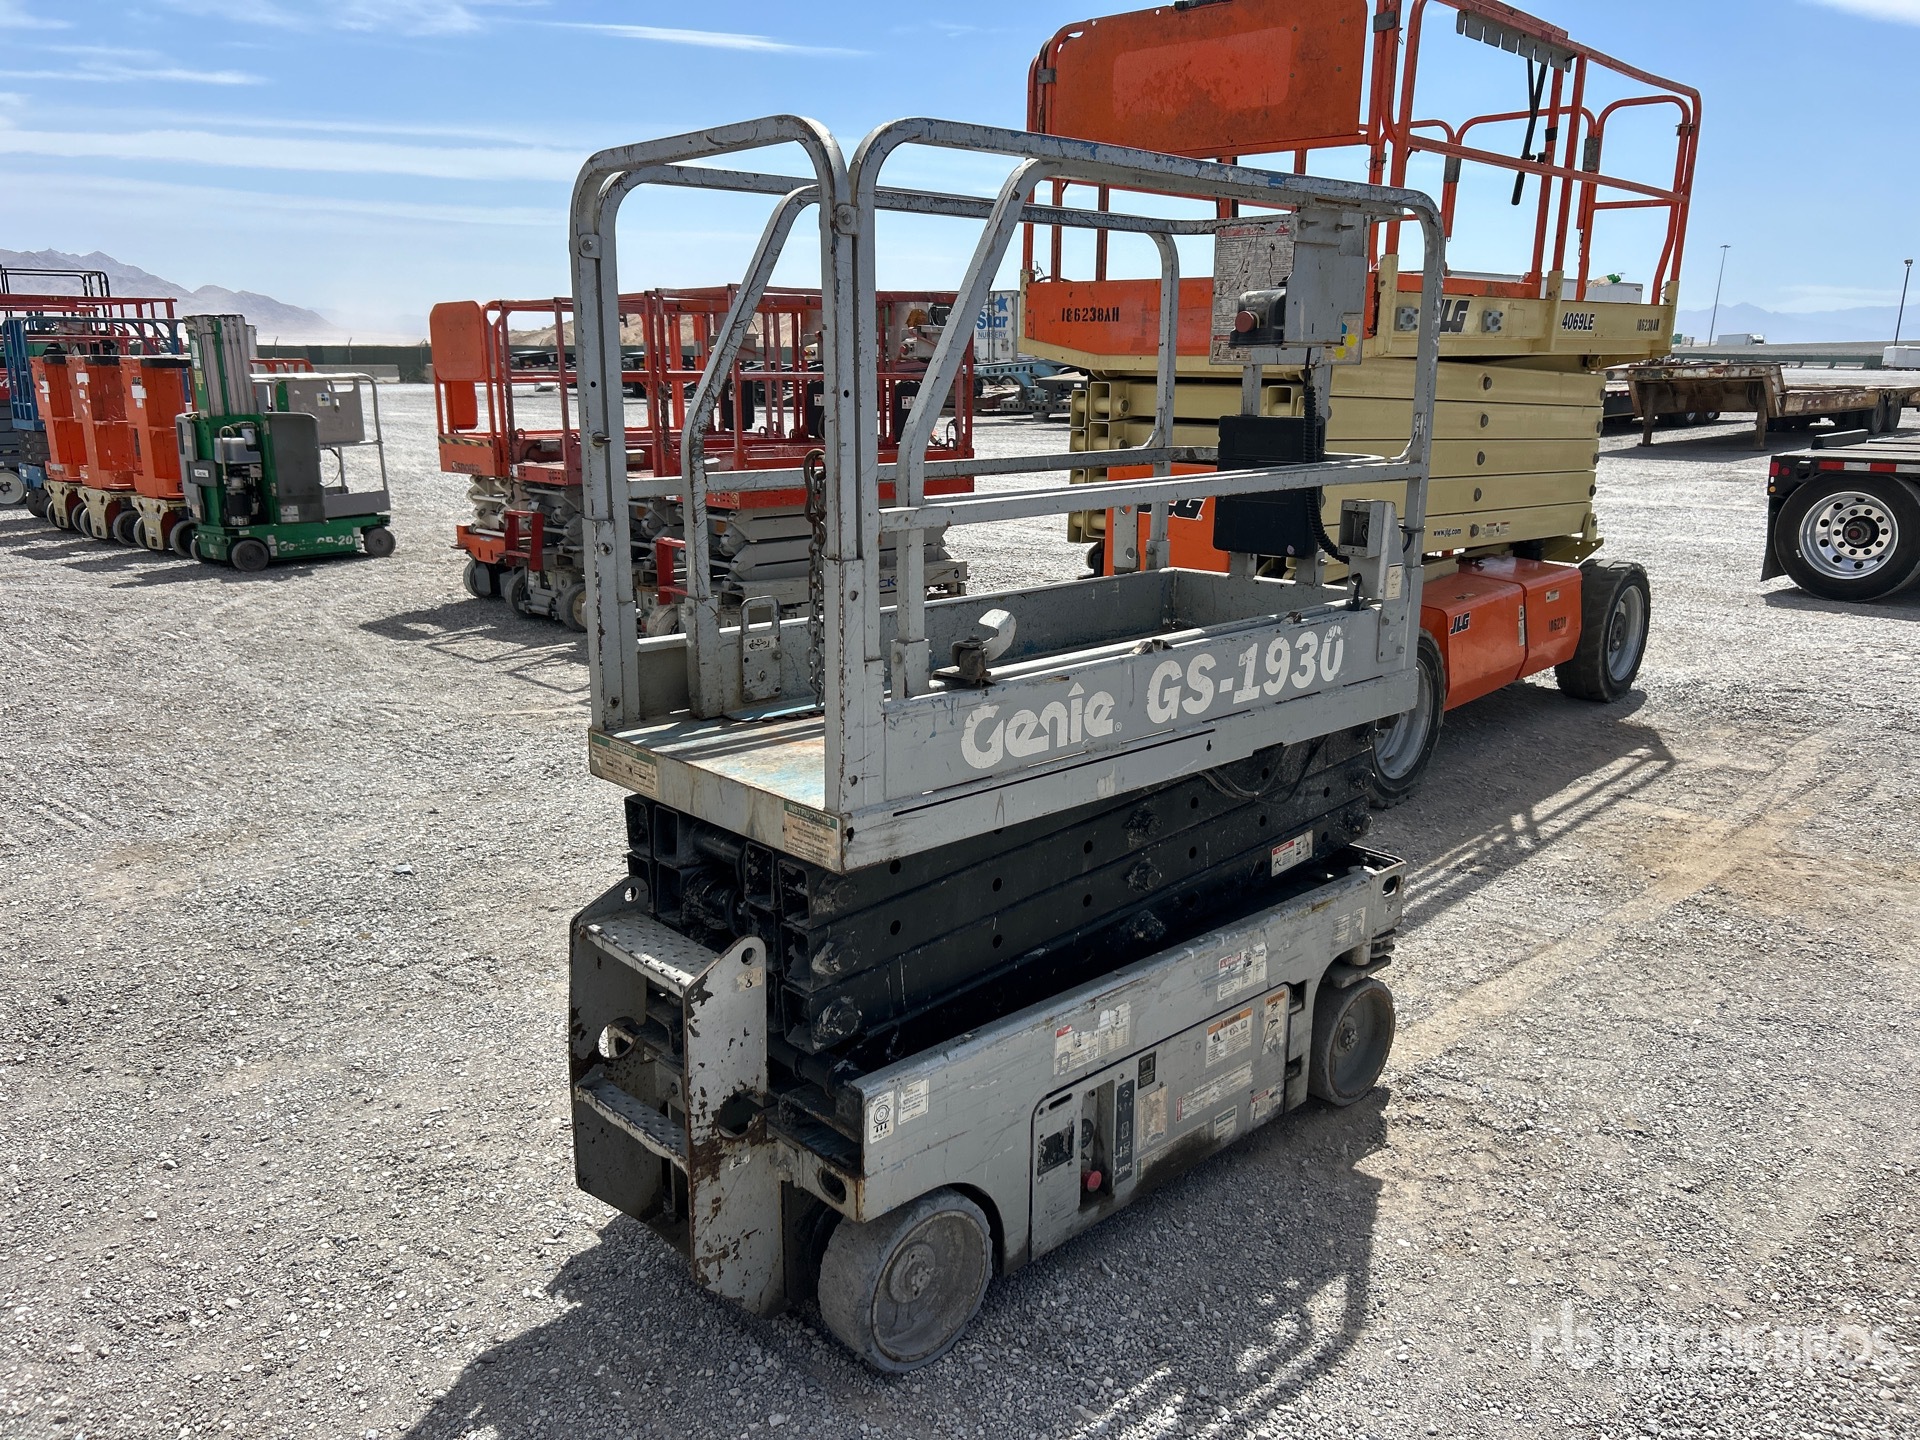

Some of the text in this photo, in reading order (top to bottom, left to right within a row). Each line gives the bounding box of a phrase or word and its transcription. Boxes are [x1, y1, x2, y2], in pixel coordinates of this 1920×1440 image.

[976, 310, 1009, 330] Star
[1440, 298, 1471, 334] LG
[1561, 312, 1595, 332] 4069LE
[1450, 611, 1471, 635] JLG
[960, 624, 1345, 770] Genie GS-1930
